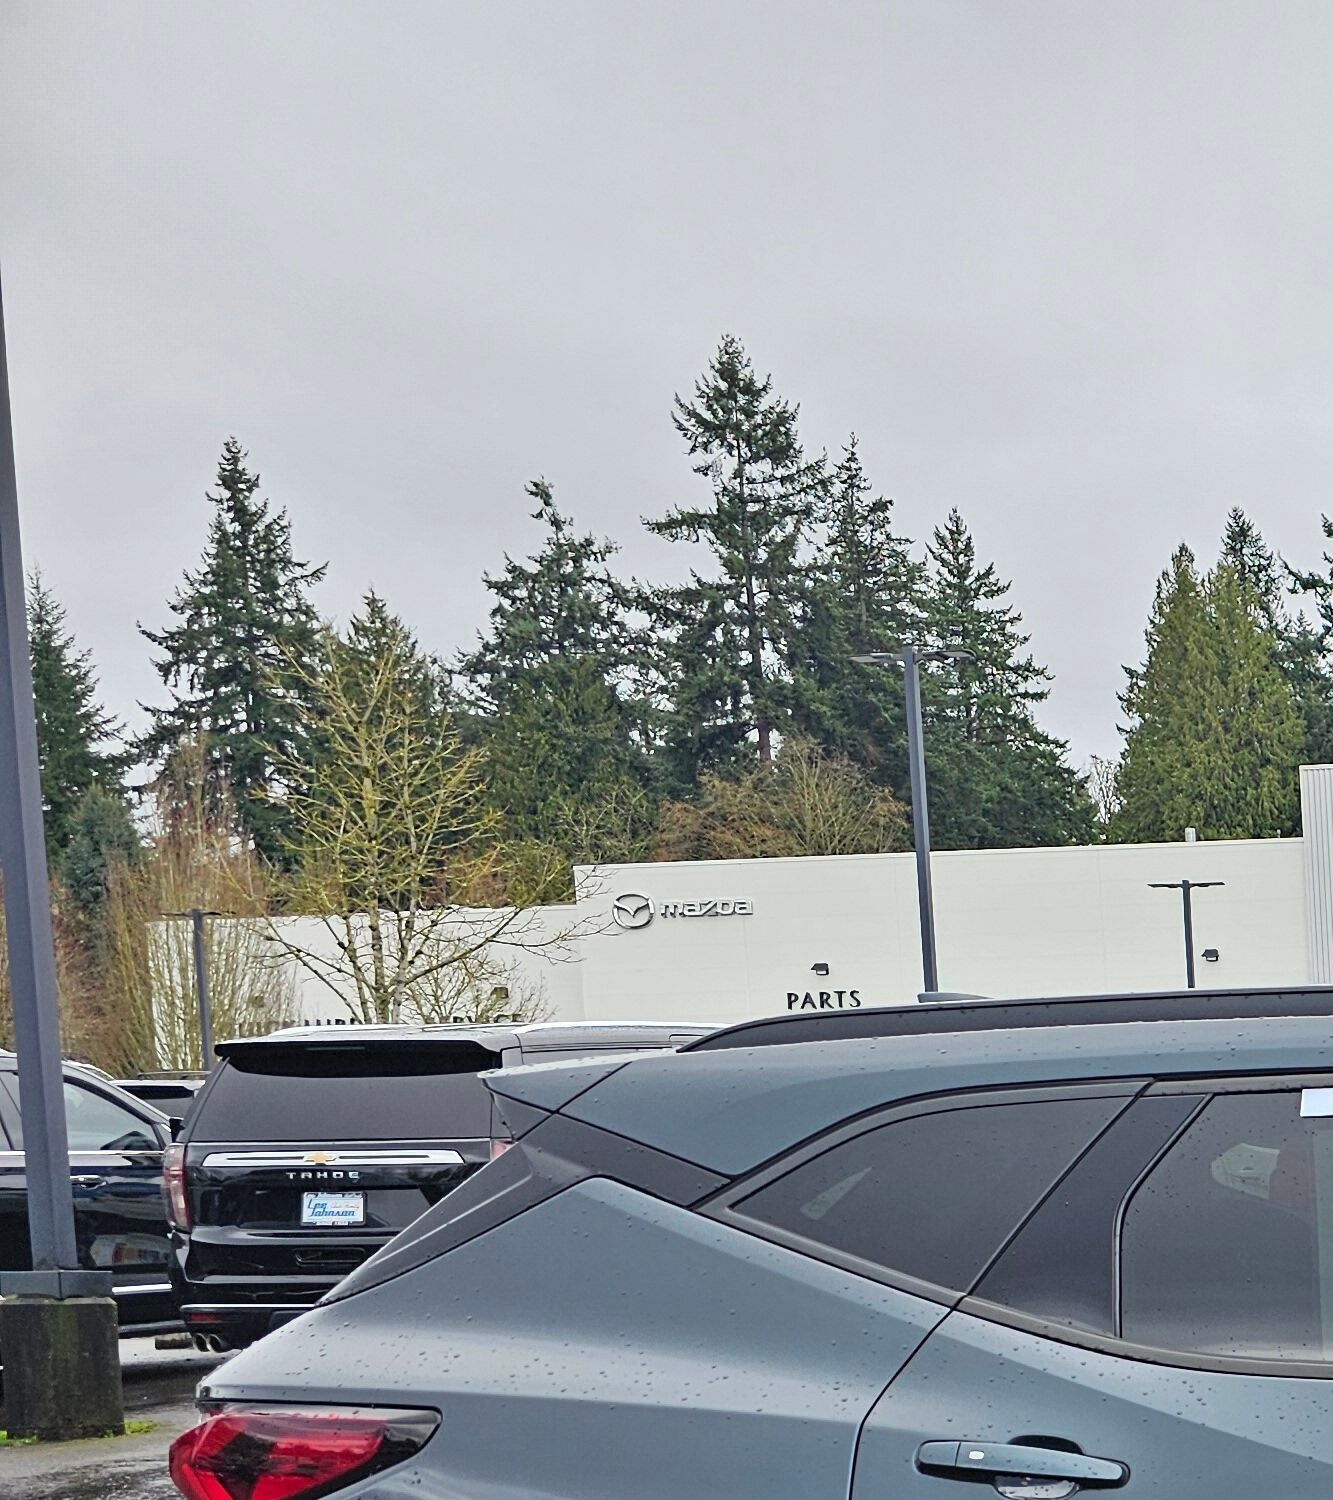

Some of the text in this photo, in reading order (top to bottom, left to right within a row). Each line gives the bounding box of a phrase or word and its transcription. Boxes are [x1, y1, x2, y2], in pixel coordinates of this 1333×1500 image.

[660, 899, 753, 918] mazda
[786, 989, 862, 1010] PARTS
[285, 1171, 360, 1180] TAHOE
[307, 1199, 328, 1209] Lee
